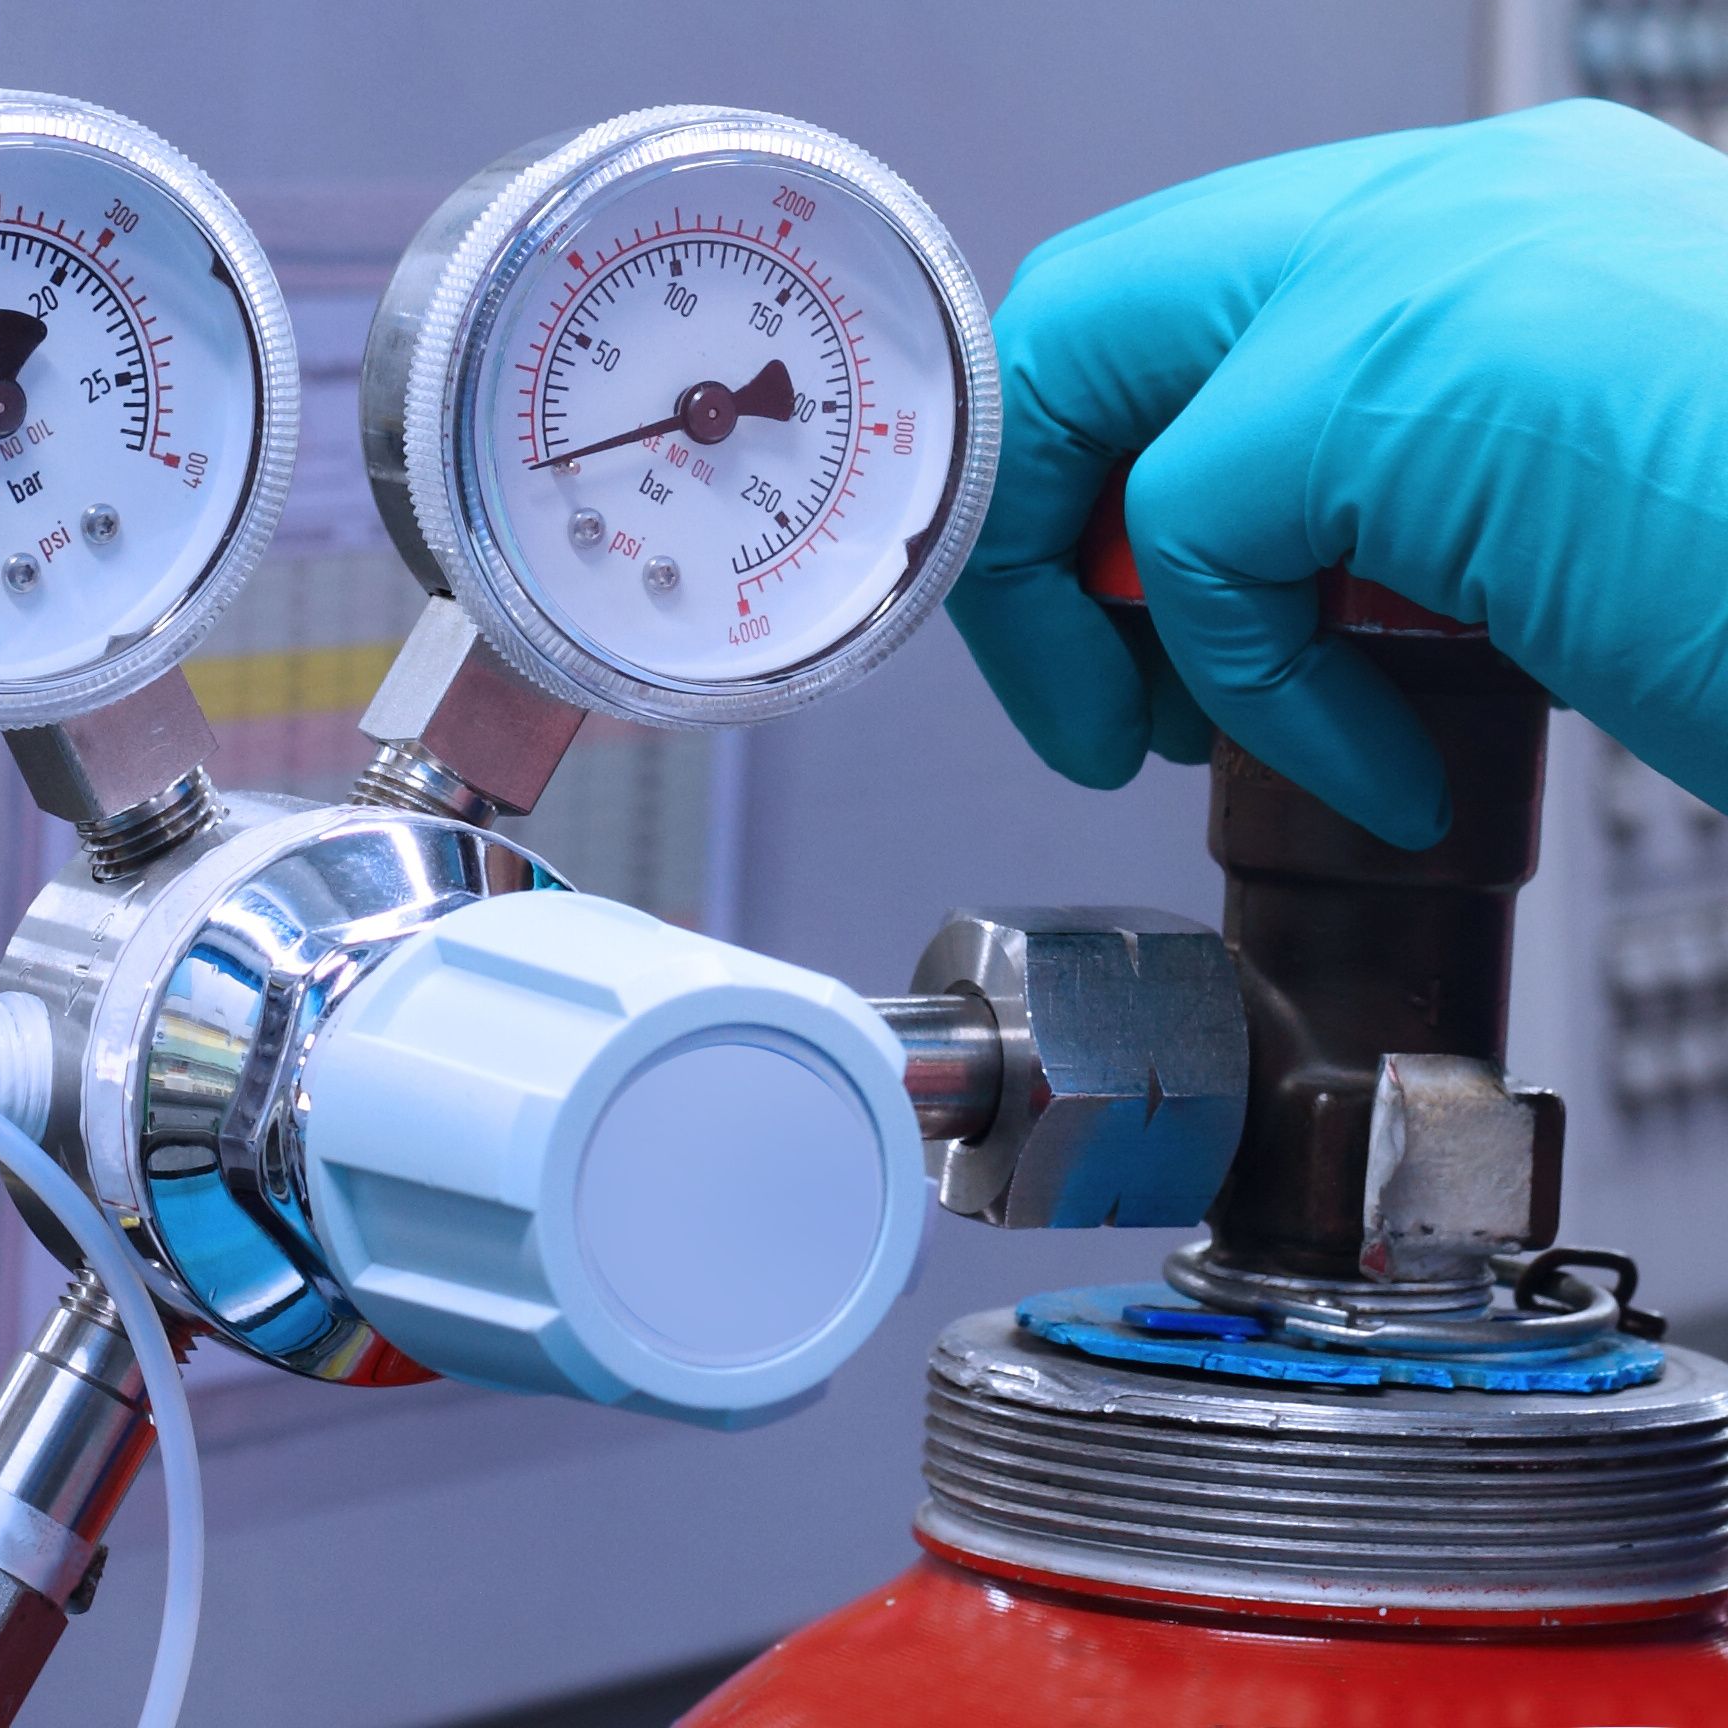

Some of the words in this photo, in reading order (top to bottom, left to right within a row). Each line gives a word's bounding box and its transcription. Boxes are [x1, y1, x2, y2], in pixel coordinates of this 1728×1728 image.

[104, 198, 140, 234] 300
[772, 185, 816, 221] 2000
[28, 285, 59, 320] 20
[663, 282, 698, 317] 100
[748, 301, 783, 337] 150
[591, 339, 621, 372] 50
[79, 368, 111, 404] 25
[0, 436, 24, 462] NO
[26, 419, 54, 446] OIL
[894, 409, 916, 455] 3000
[182, 452, 209, 489] 400
[665, 443, 689, 468] NO
[691, 459, 714, 486] OIL
[7, 470, 45, 504] bar
[639, 469, 674, 505] bar
[740, 475, 782, 513] 250
[38, 520, 72, 563] psi
[608, 530, 646, 560] psi
[728, 615, 770, 646] 4000
